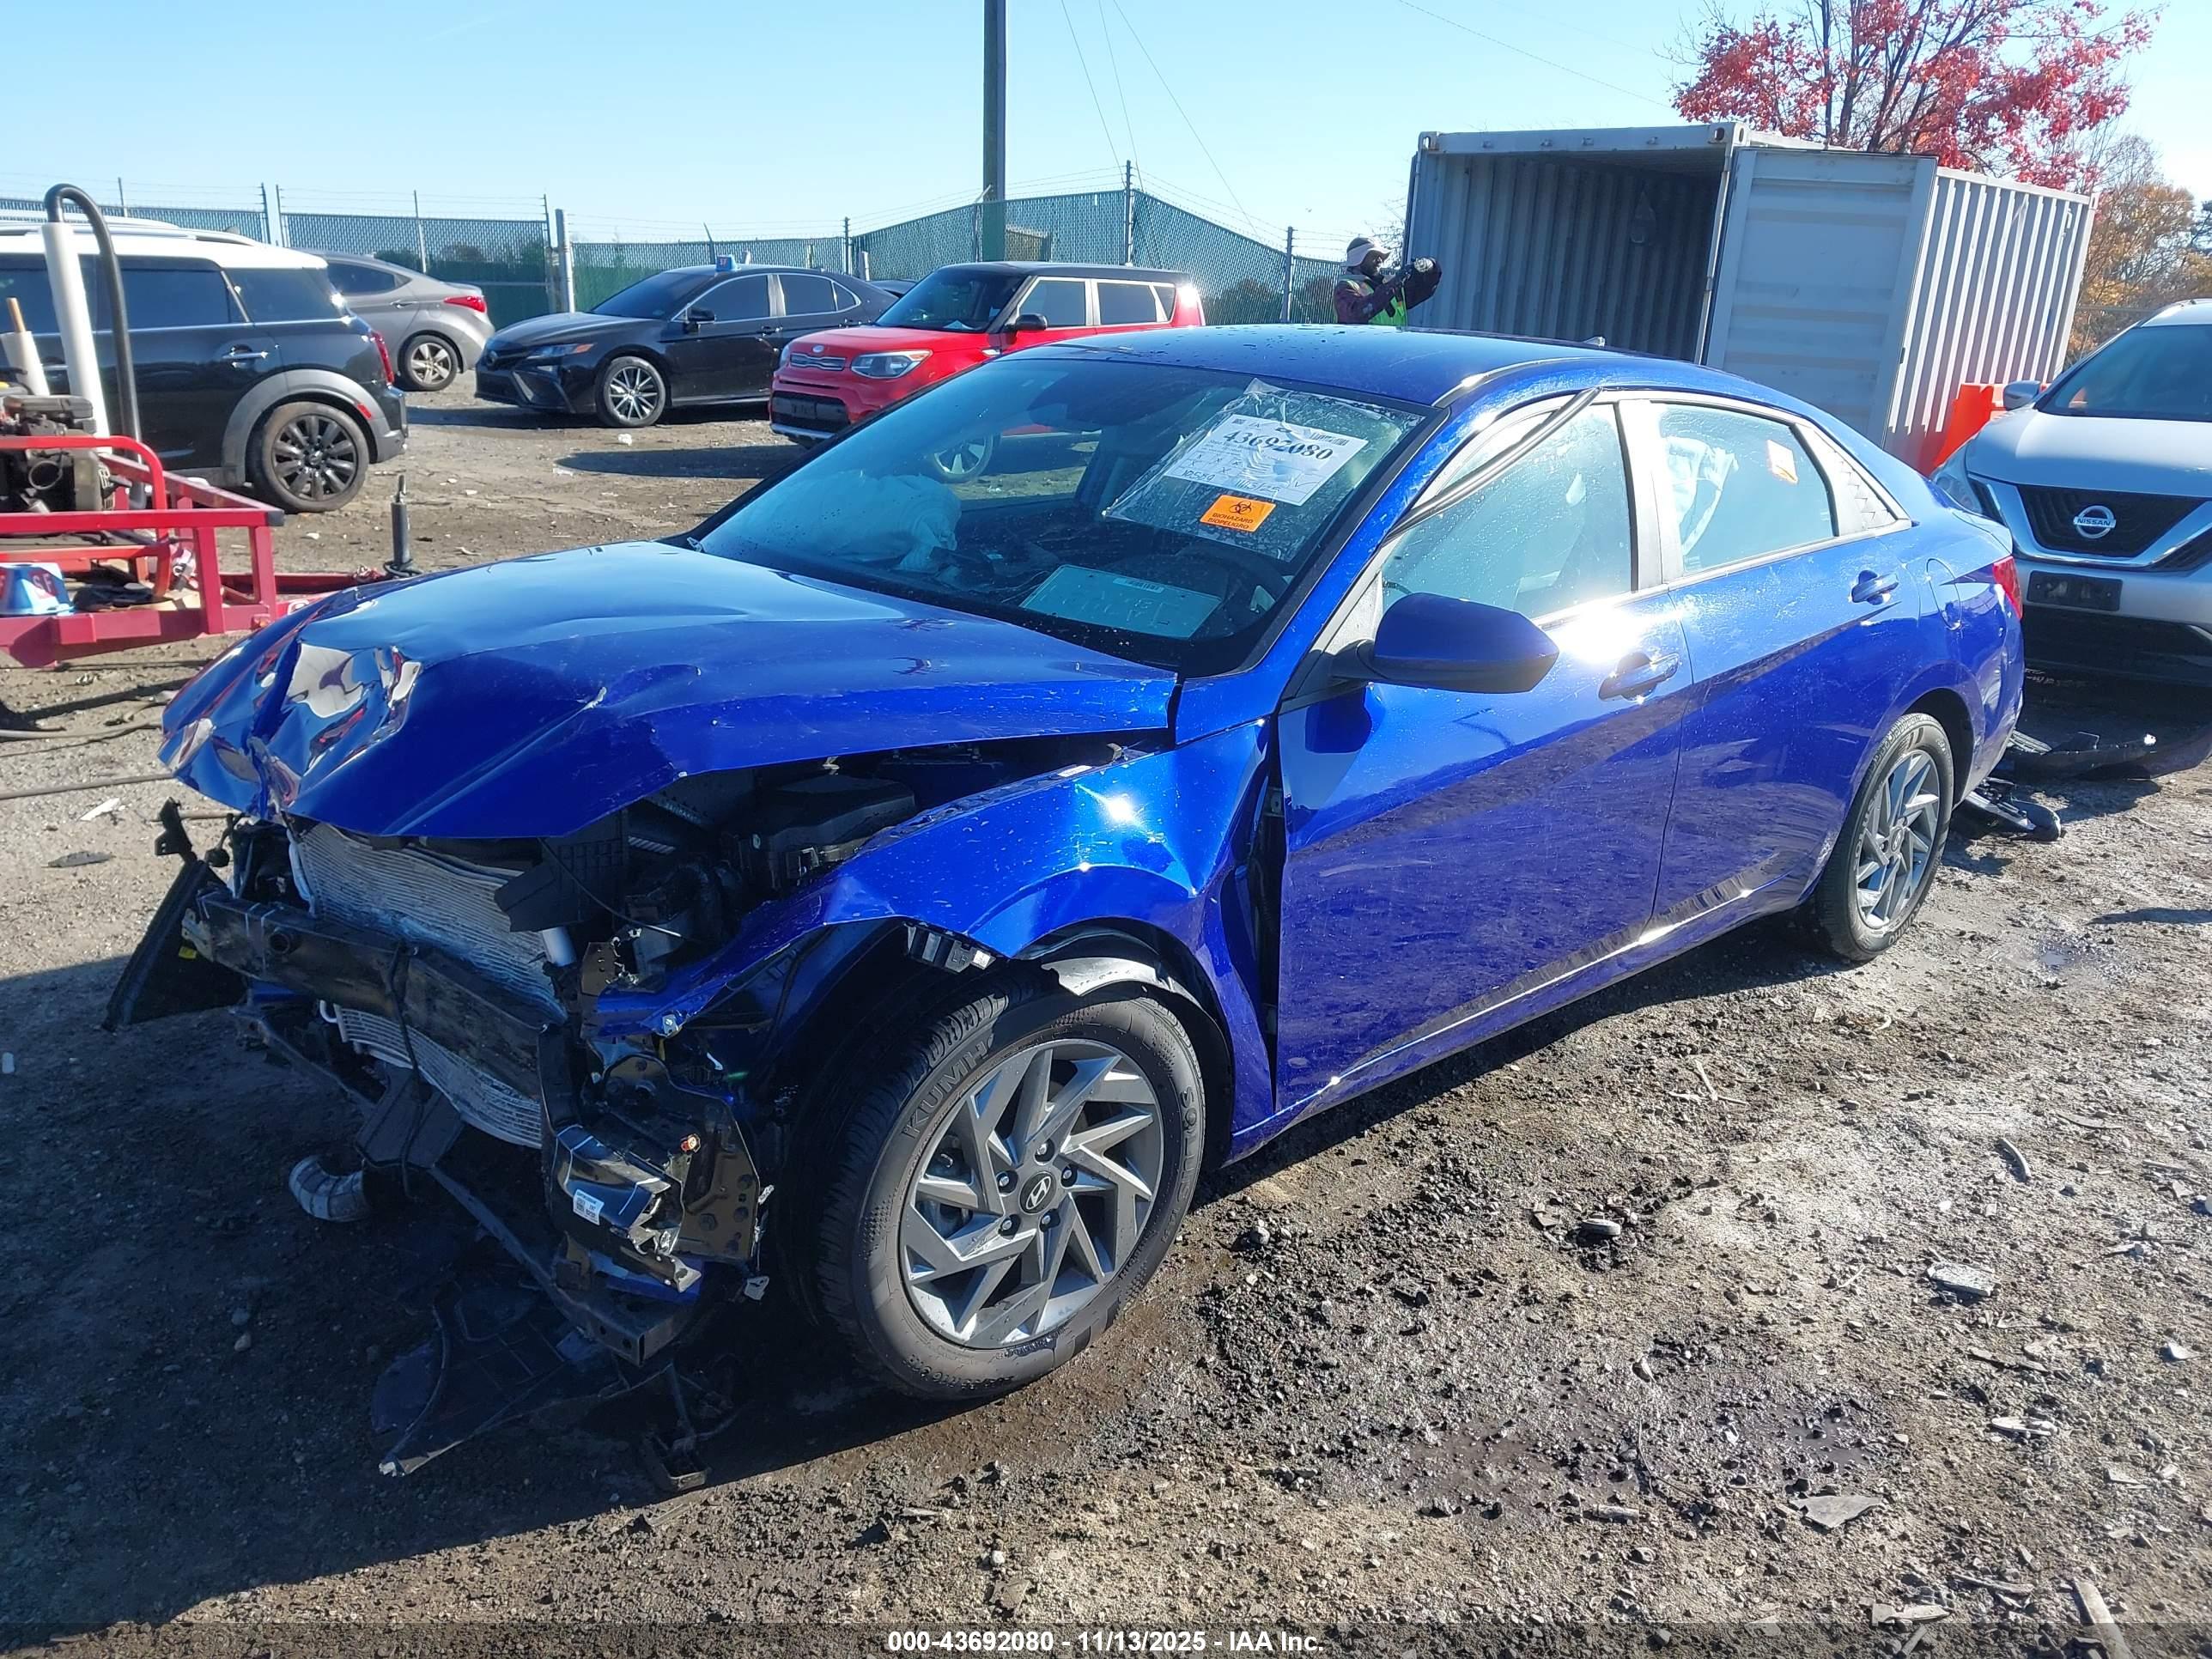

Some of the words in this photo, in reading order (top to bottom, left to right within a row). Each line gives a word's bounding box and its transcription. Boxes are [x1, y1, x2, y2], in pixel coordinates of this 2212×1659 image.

[1223, 430, 1334, 460] 43692080
[1207, 518, 1249, 530] BIOPELIGRO
[1212, 513, 1254, 524] BIOHAZARD
[2077, 518, 2111, 526] NISSAN
[1177, 1085, 1197, 1203] SOLUS
